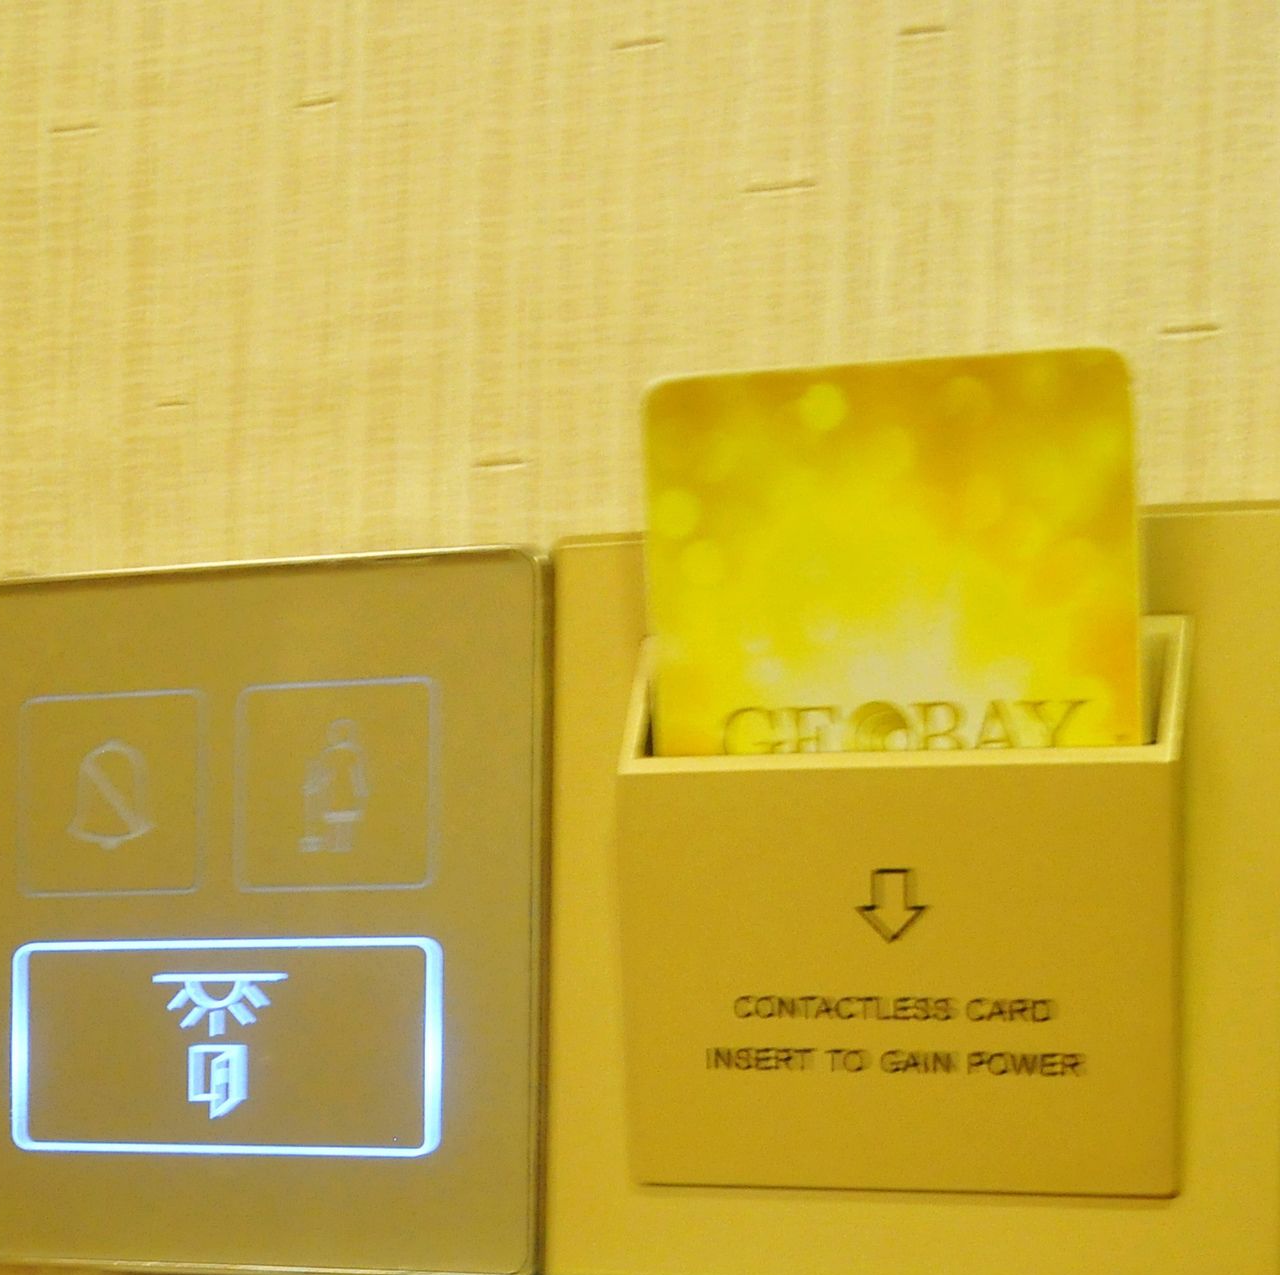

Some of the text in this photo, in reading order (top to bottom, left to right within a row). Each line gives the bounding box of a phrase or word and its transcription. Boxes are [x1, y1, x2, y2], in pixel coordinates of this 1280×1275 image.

[732, 995, 1058, 1023] CONTACTLESS CARD
[706, 1047, 1087, 1077] INSERT TO GAIN POWER
